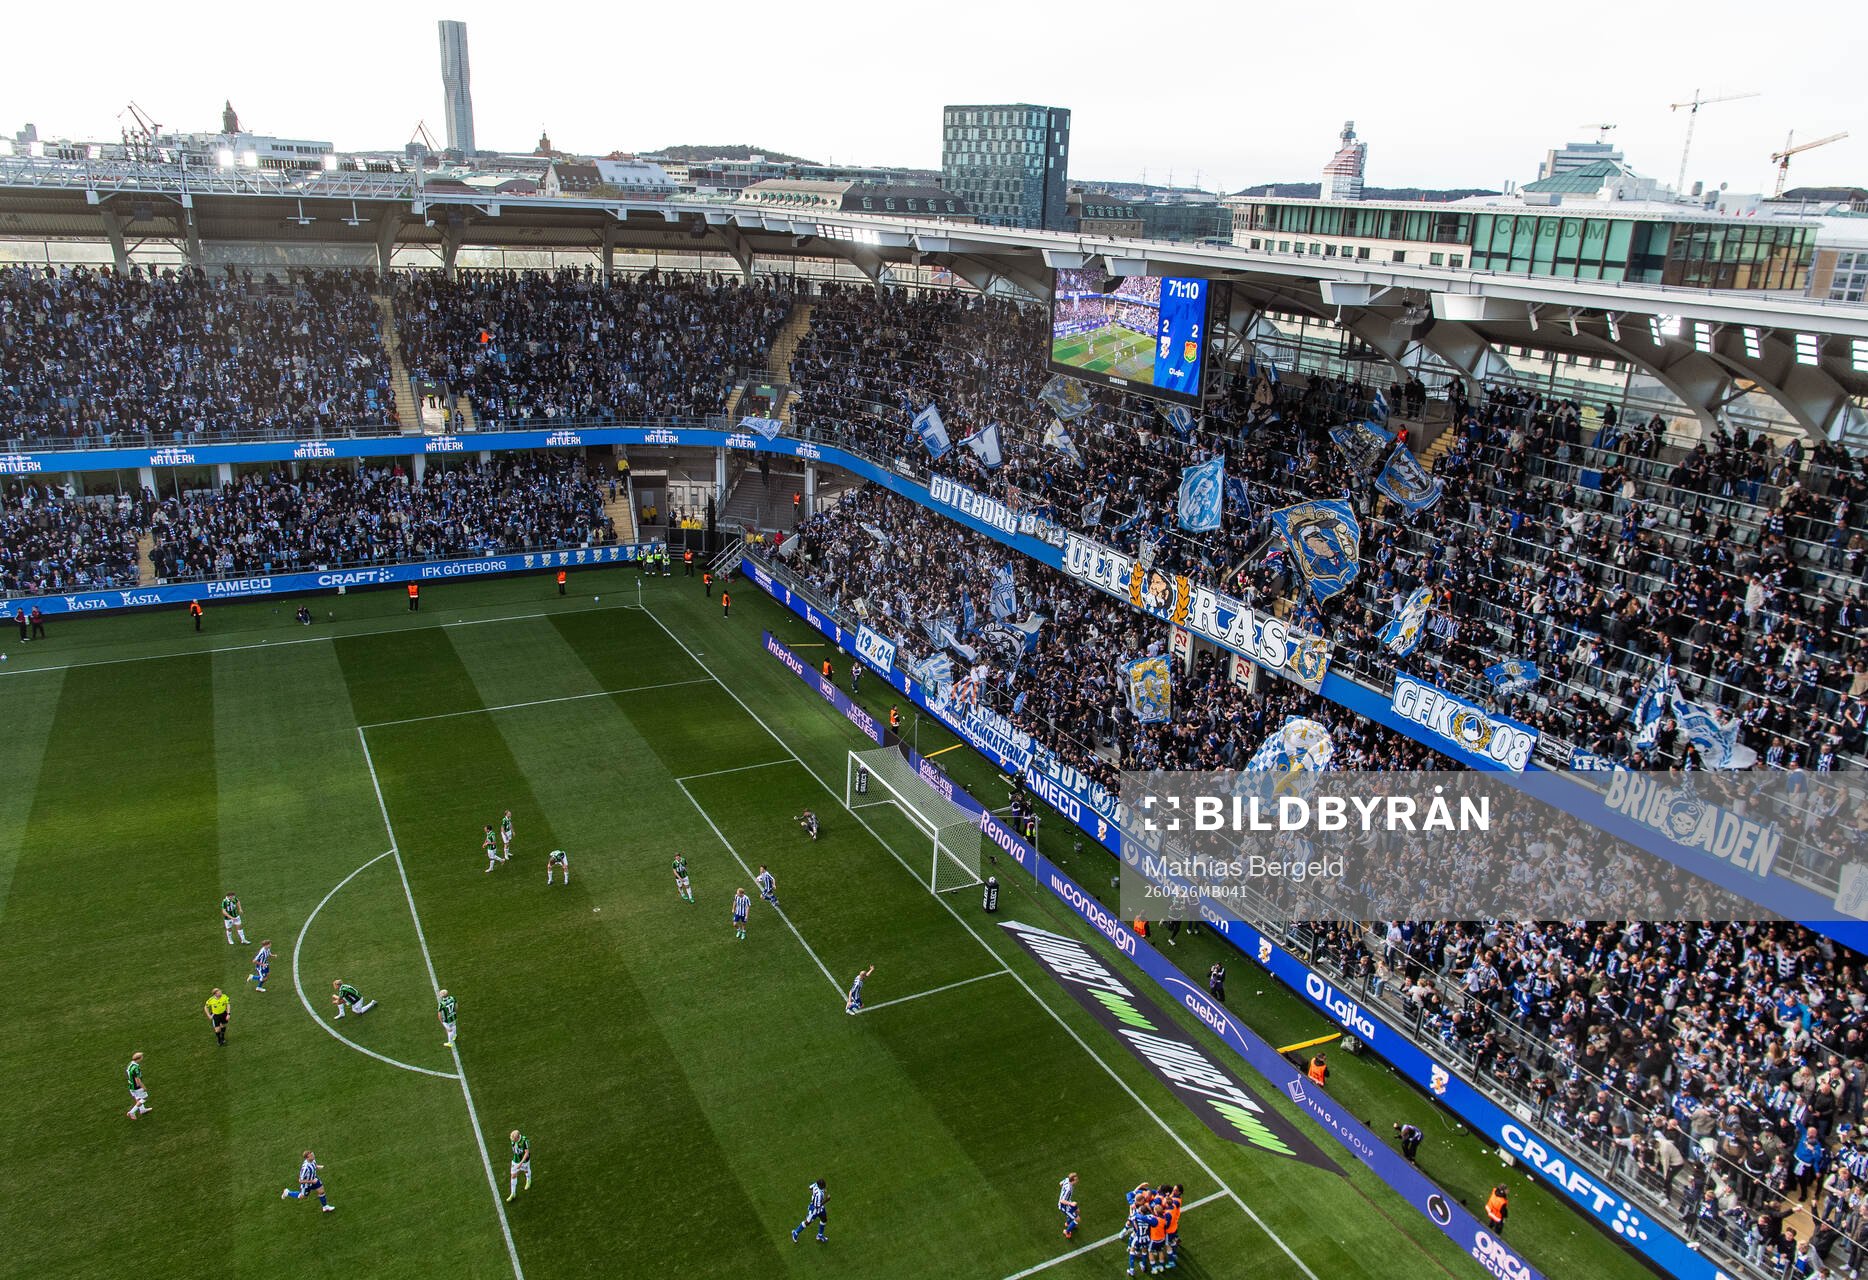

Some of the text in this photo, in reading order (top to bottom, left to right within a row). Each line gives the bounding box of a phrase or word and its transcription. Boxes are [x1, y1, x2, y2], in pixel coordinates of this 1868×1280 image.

[1168, 280, 1199, 300] 71:10
[1162, 319, 1198, 338] 2 2
[318, 570, 378, 586] CRAFT
[422, 560, 507, 577] IFK GÖTEBORG
[207, 577, 272, 594] FAMECO
[68, 599, 107, 611] RASTA
[123, 594, 161, 606] RASTA
[767, 636, 803, 675] Interbus
[846, 708, 878, 741] WELLNESS
[851, 703, 873, 727] NORDIC
[1393, 680, 1532, 771] GFK 08
[966, 715, 1029, 768] KAMRATERNA
[980, 810, 1025, 863] Renova
[1186, 993, 1226, 1036] cuebid
[1308, 1097, 1374, 1158] VINGA GROUP
[1501, 1124, 1615, 1213] CRAFT
